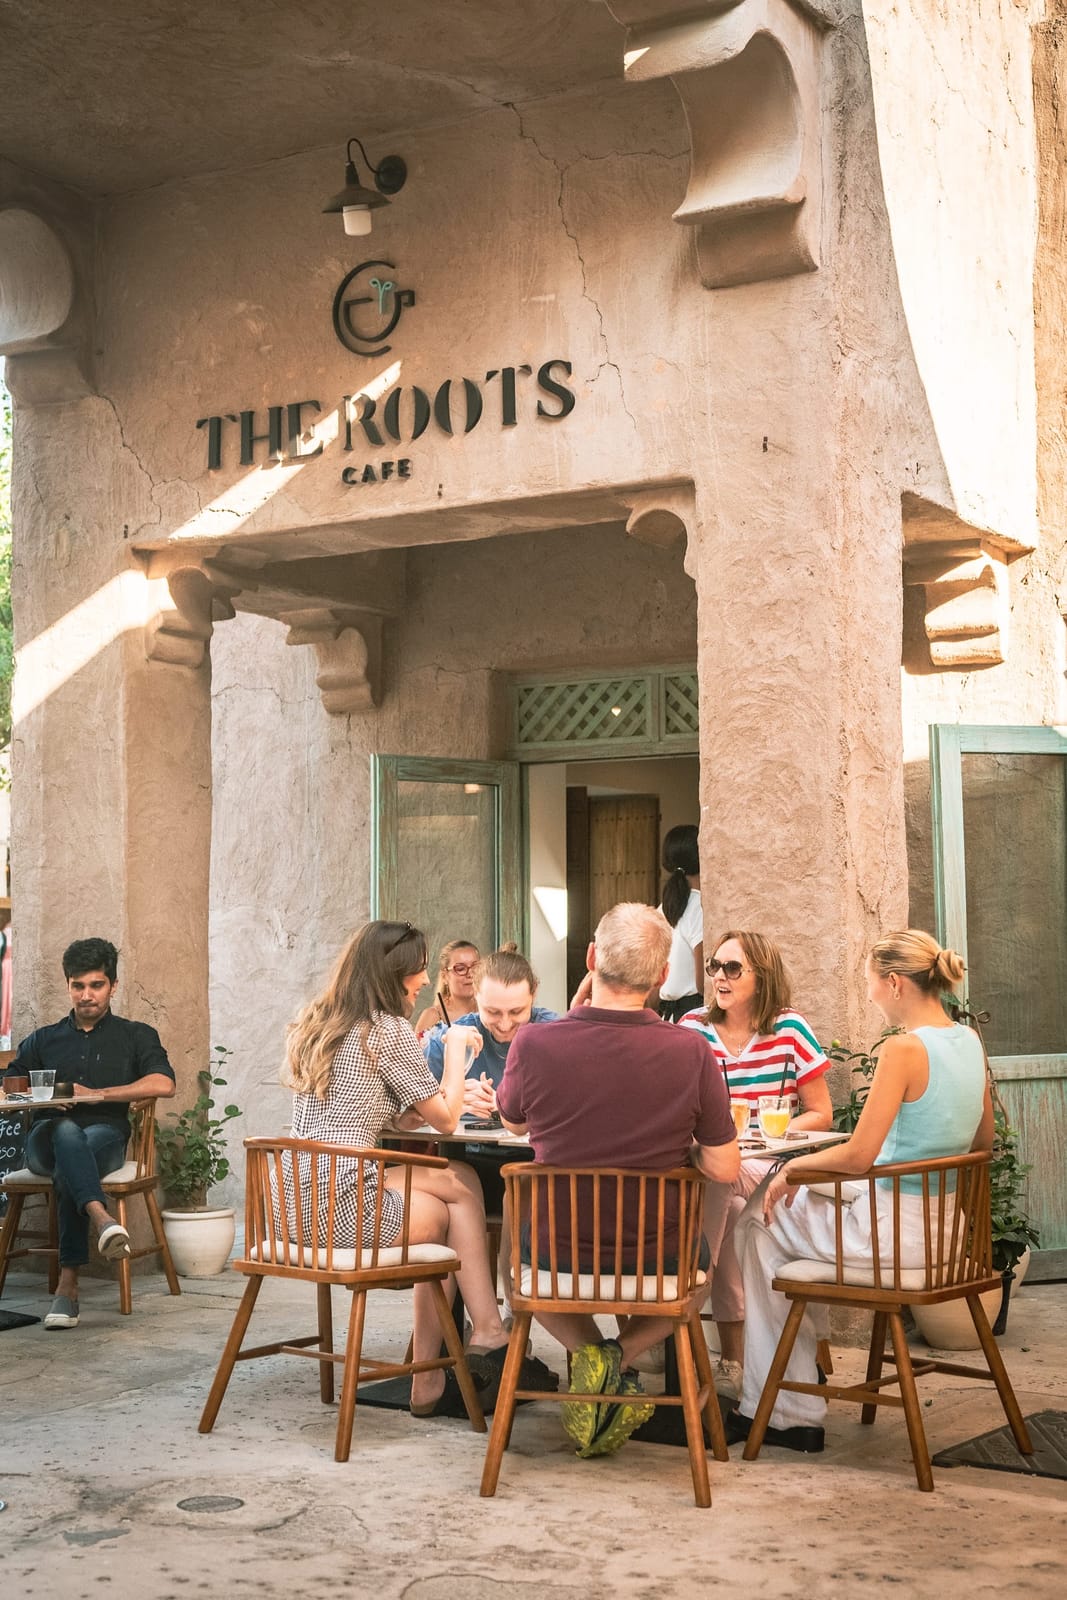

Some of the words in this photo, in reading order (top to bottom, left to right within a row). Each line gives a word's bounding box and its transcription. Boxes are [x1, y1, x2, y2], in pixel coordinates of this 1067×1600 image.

[196, 399, 324, 470] THE
[343, 359, 576, 451] ROOTS
[342, 458, 412, 485] CAFE
[0, 1118, 21, 1139] fee
